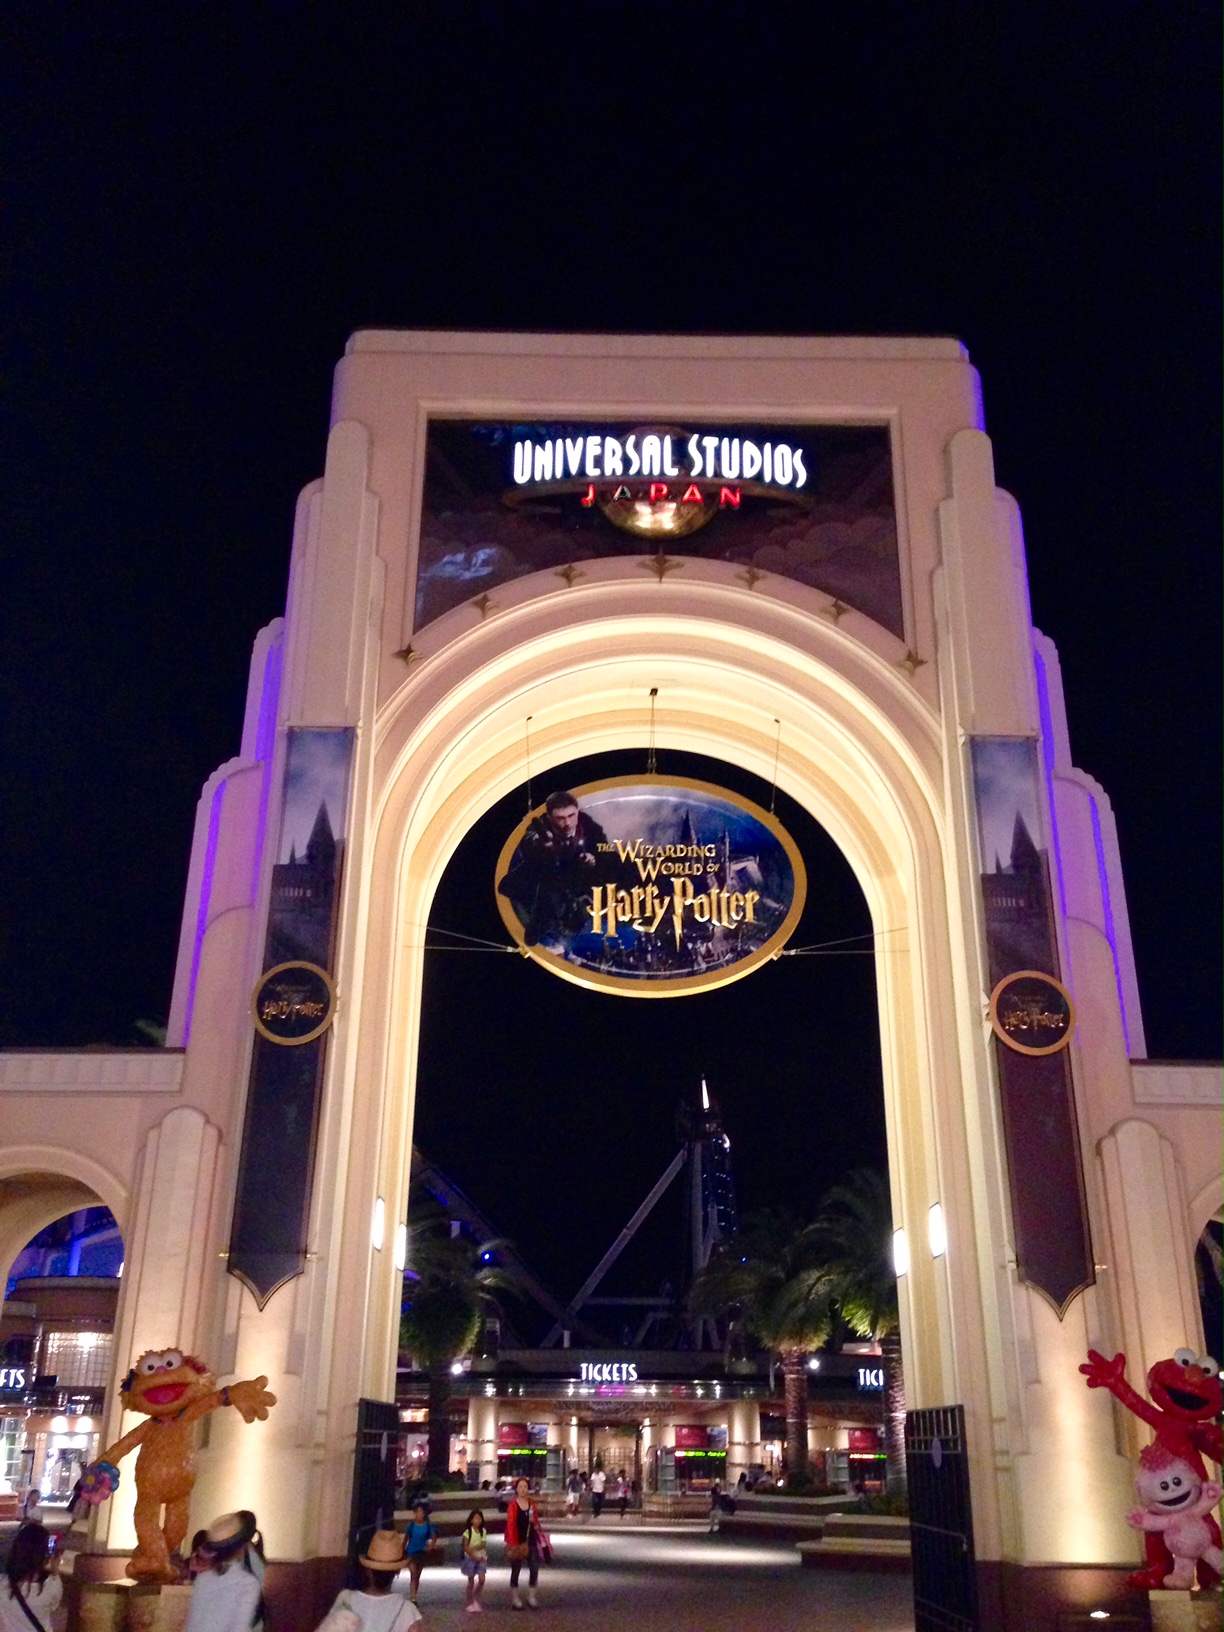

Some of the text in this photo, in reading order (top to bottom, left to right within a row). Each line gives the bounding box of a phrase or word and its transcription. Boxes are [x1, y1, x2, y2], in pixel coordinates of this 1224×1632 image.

[513, 433, 807, 489] UNIVERSAL STUDIOS
[581, 482, 741, 507] JAPAN
[586, 876, 761, 952] Harry Potter
[580, 1363, 638, 1382] TICKETS
